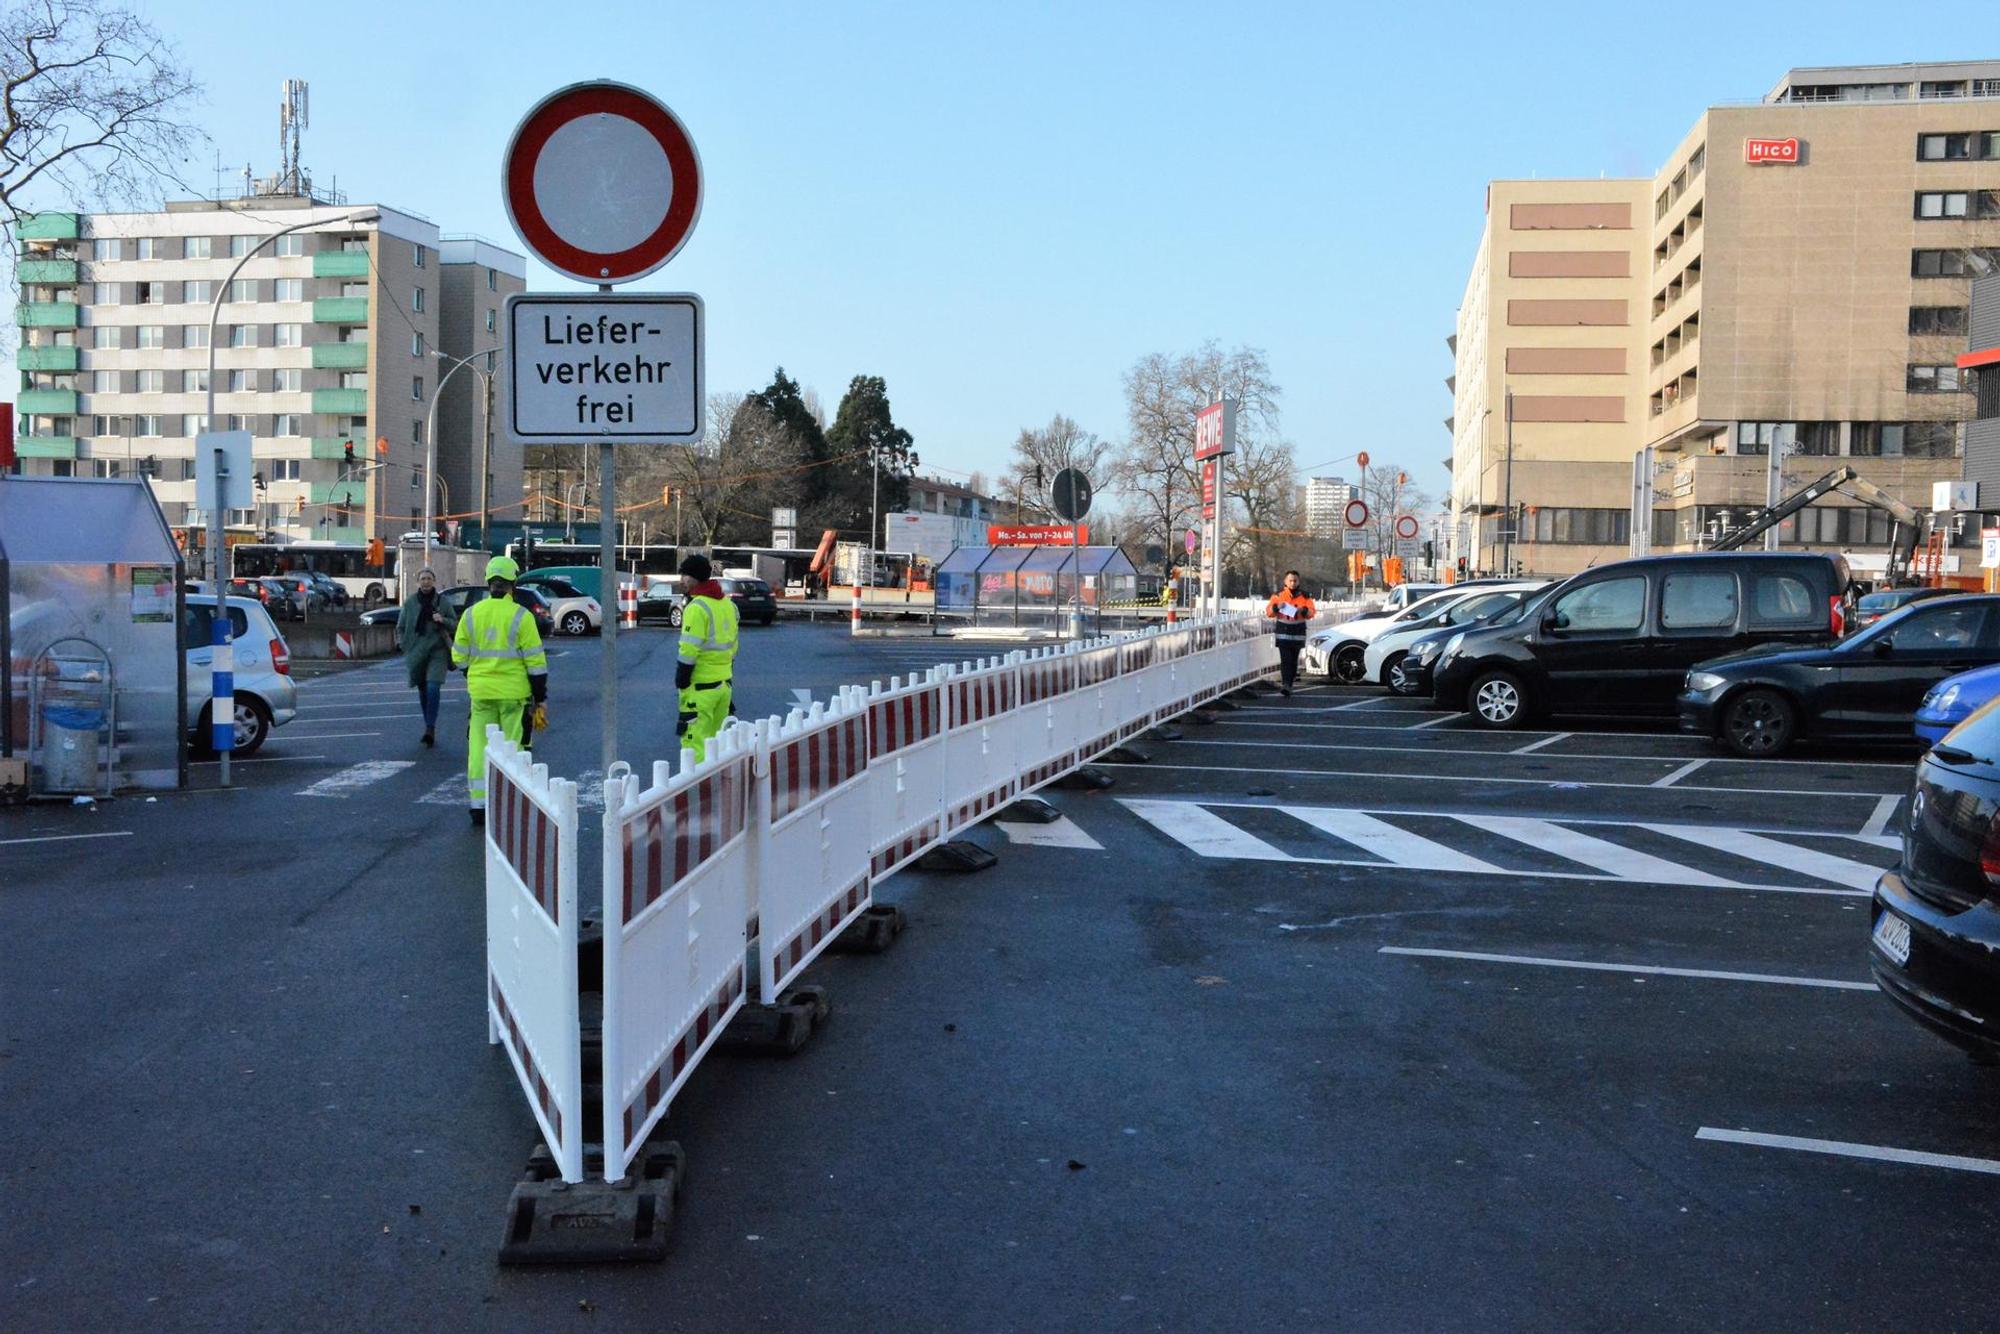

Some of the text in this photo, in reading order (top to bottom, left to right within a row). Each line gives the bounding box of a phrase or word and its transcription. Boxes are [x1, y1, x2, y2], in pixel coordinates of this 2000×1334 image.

[544, 314, 661, 345] Liefer-
[536, 355, 672, 385] verkehr
[577, 395, 633, 424] frei
[1196, 409, 1222, 452] REWE
[1030, 532, 1043, 540] von
[1063, 531, 1074, 540] Uh
